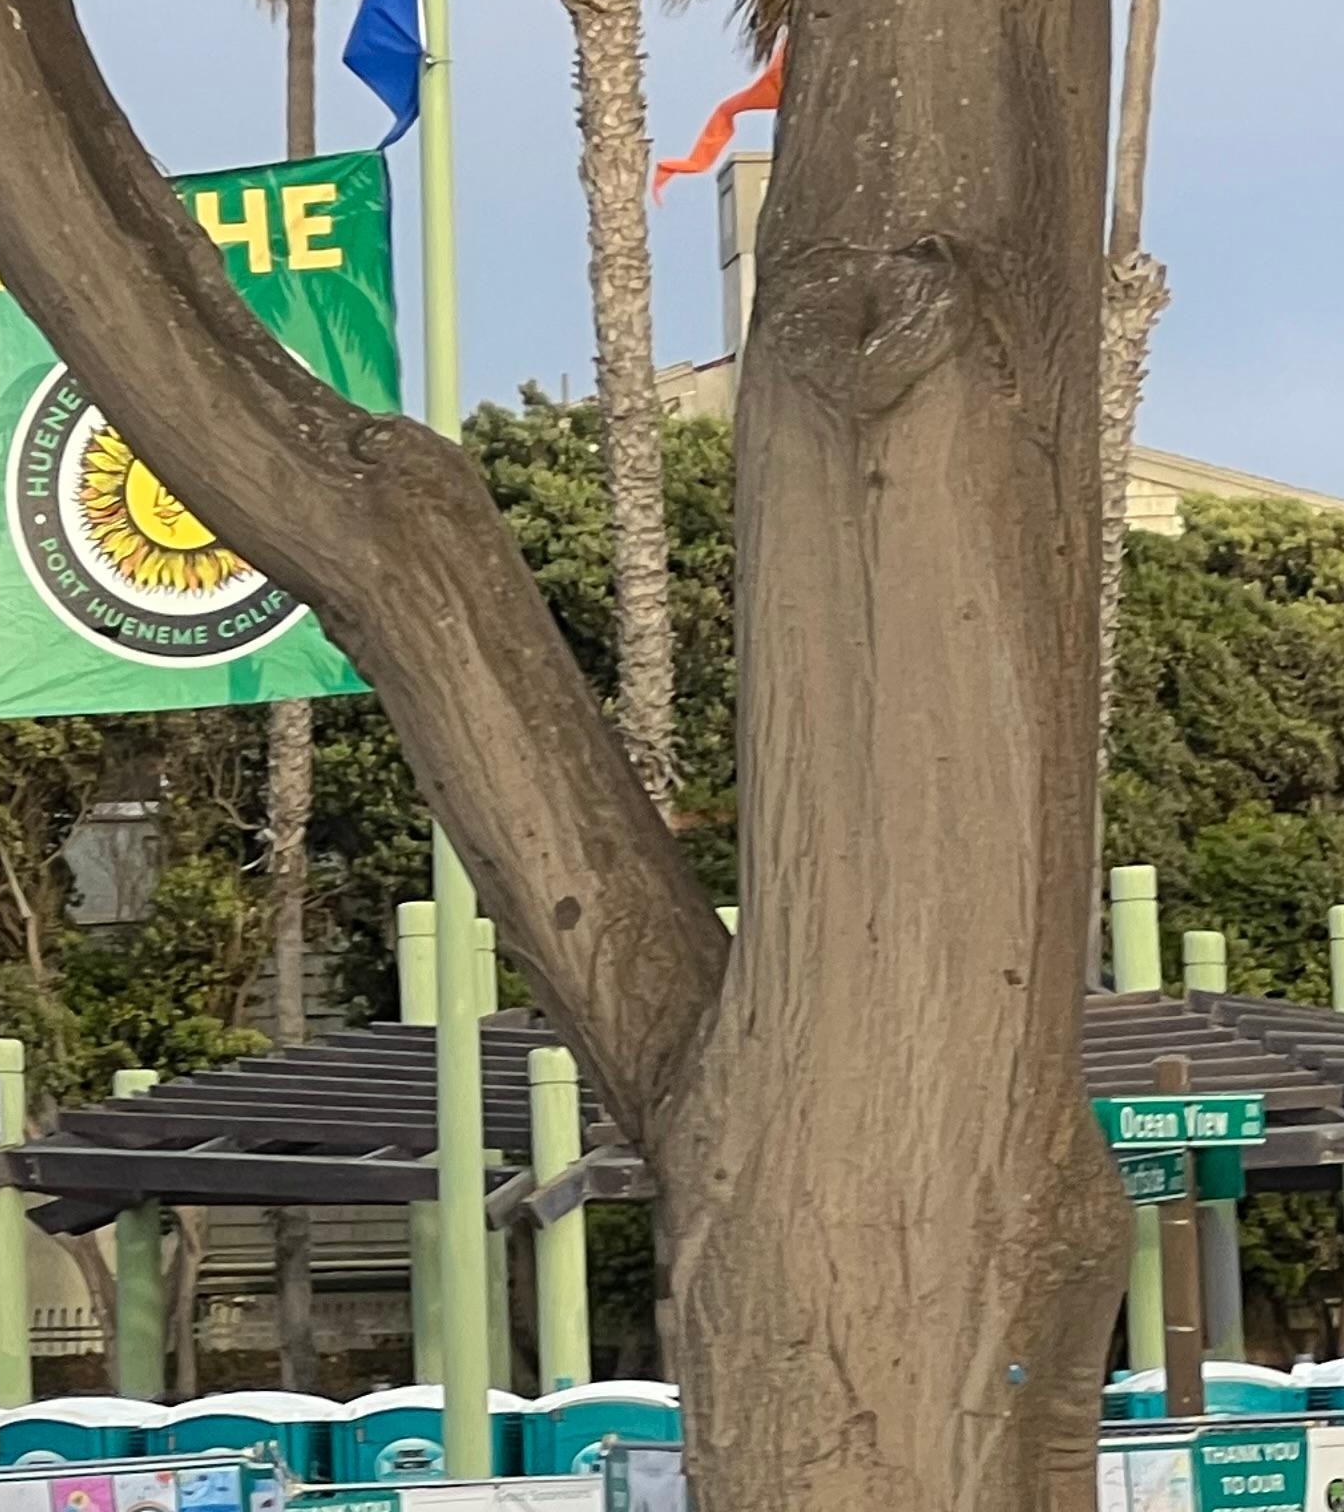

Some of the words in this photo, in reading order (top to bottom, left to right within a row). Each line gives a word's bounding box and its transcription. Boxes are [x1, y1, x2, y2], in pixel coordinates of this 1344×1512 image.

[176, 183, 343, 273] HE
[26, 378, 84, 497] HUENE
[38, 537, 91, 599] PORT
[86, 597, 209, 645] HUENEME
[217, 588, 289, 638] CALIF
[1120, 1106, 1179, 1138] Ocean
[1184, 1104, 1229, 1137] View
[1201, 1444, 1263, 1465] THANK
[1263, 1441, 1301, 1462] YOU
[1220, 1475, 1246, 1495] TO
[1247, 1473, 1285, 1494] OUR
